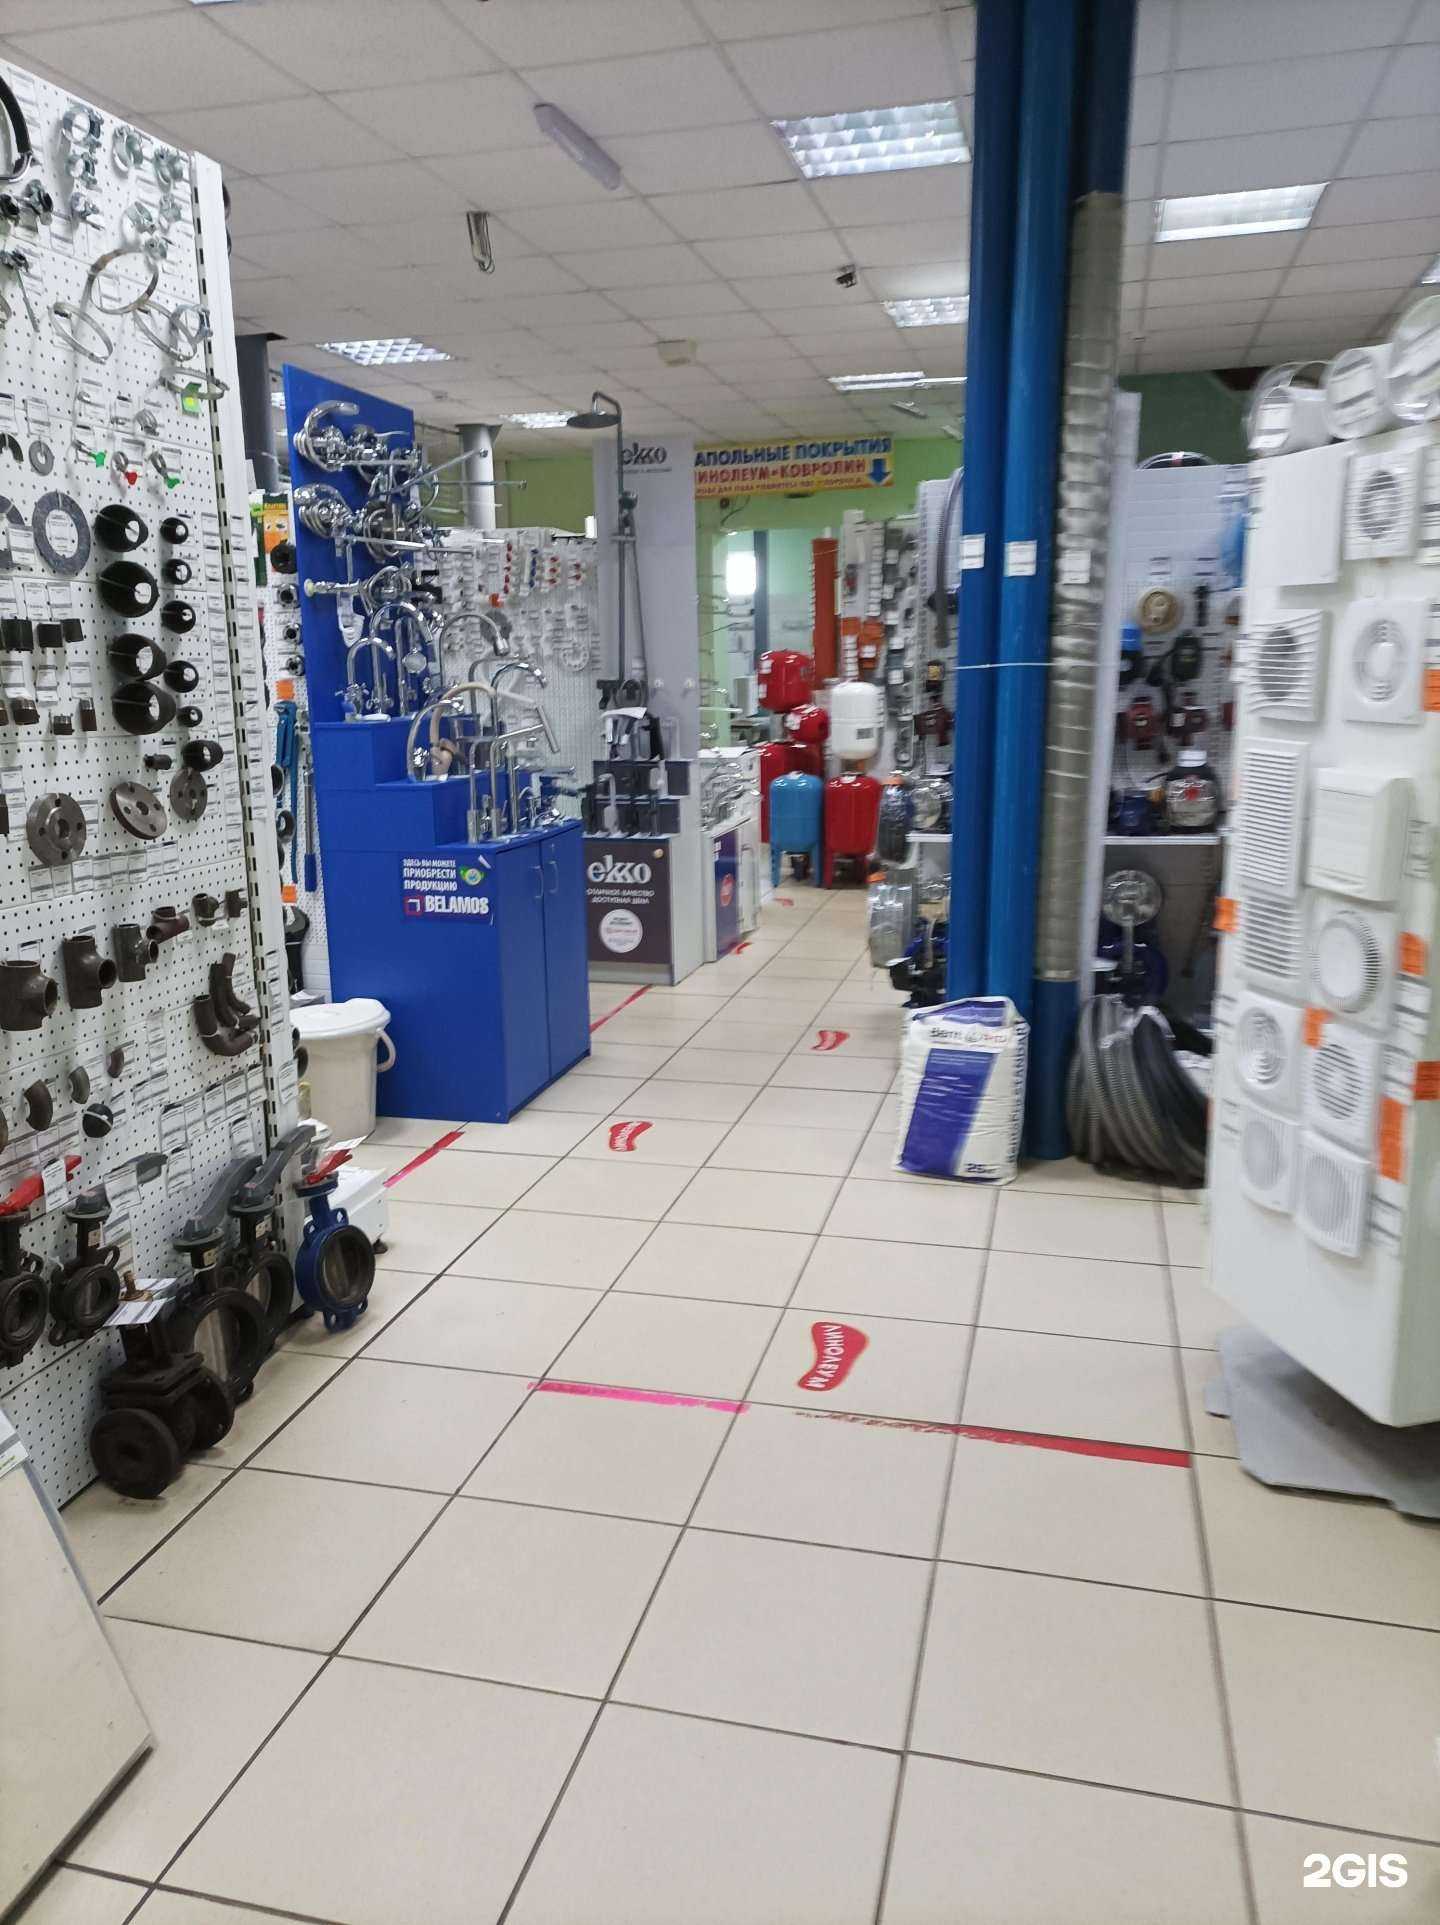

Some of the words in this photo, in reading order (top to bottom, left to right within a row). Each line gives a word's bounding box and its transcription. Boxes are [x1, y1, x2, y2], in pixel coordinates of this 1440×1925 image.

[694, 449, 791, 467] АПОЛЬНЫЕ
[795, 437, 891, 460] ПОКРЫТИЯ
[403, 867, 456, 879] ПРИОБРЕСТИ
[587, 855, 652, 884] ekko
[404, 880, 457, 892] ПРОДУКЦИЮ
[425, 895, 489, 914] BELAMOS
[805, 1324, 845, 1388] ЛИНОЛЕУМ
